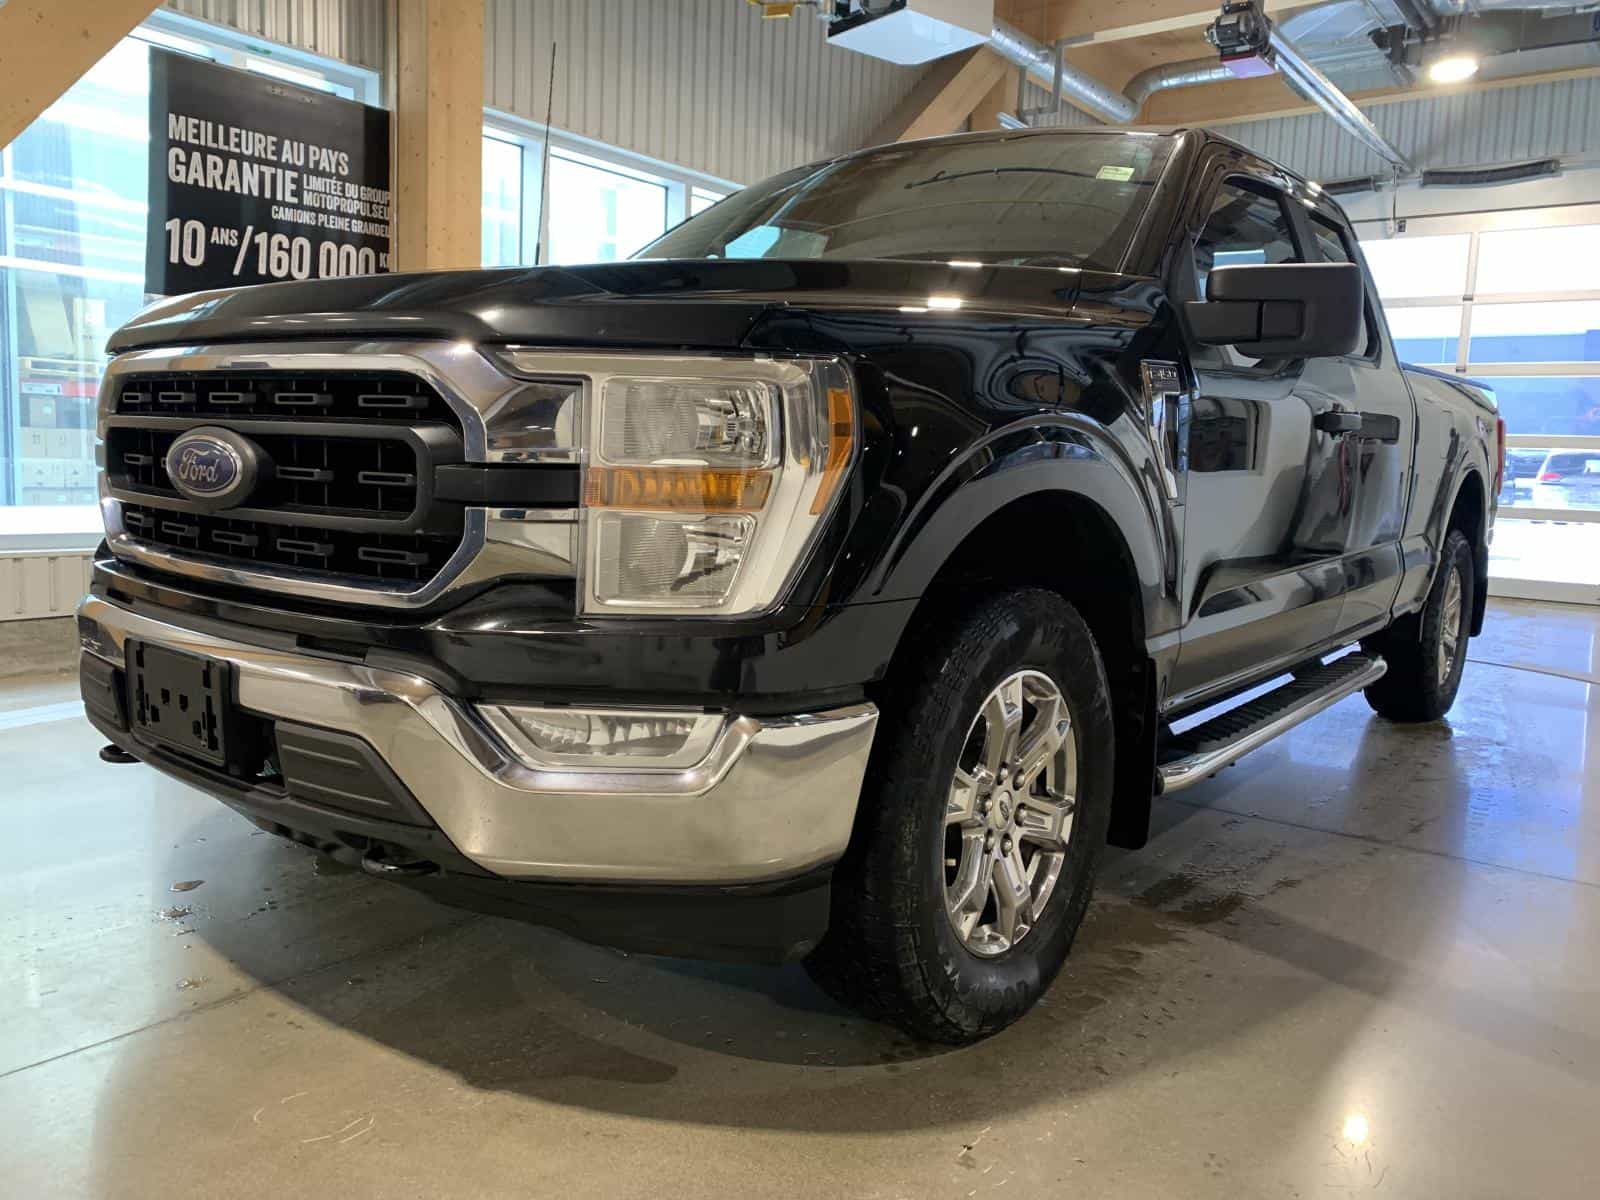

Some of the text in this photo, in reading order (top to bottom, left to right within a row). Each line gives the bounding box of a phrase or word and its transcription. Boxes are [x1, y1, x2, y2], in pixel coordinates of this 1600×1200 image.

[168, 112, 349, 176] MEILLEURE AU PAYS
[168, 147, 298, 204] GARANTIE
[303, 173, 343, 196] LIMITÉE
[345, 182, 358, 199] DU
[271, 205, 316, 226] CAMIONS
[318, 213, 350, 232] PLEINE
[165, 217, 205, 267] 10
[179, 448, 219, 482] Ford
